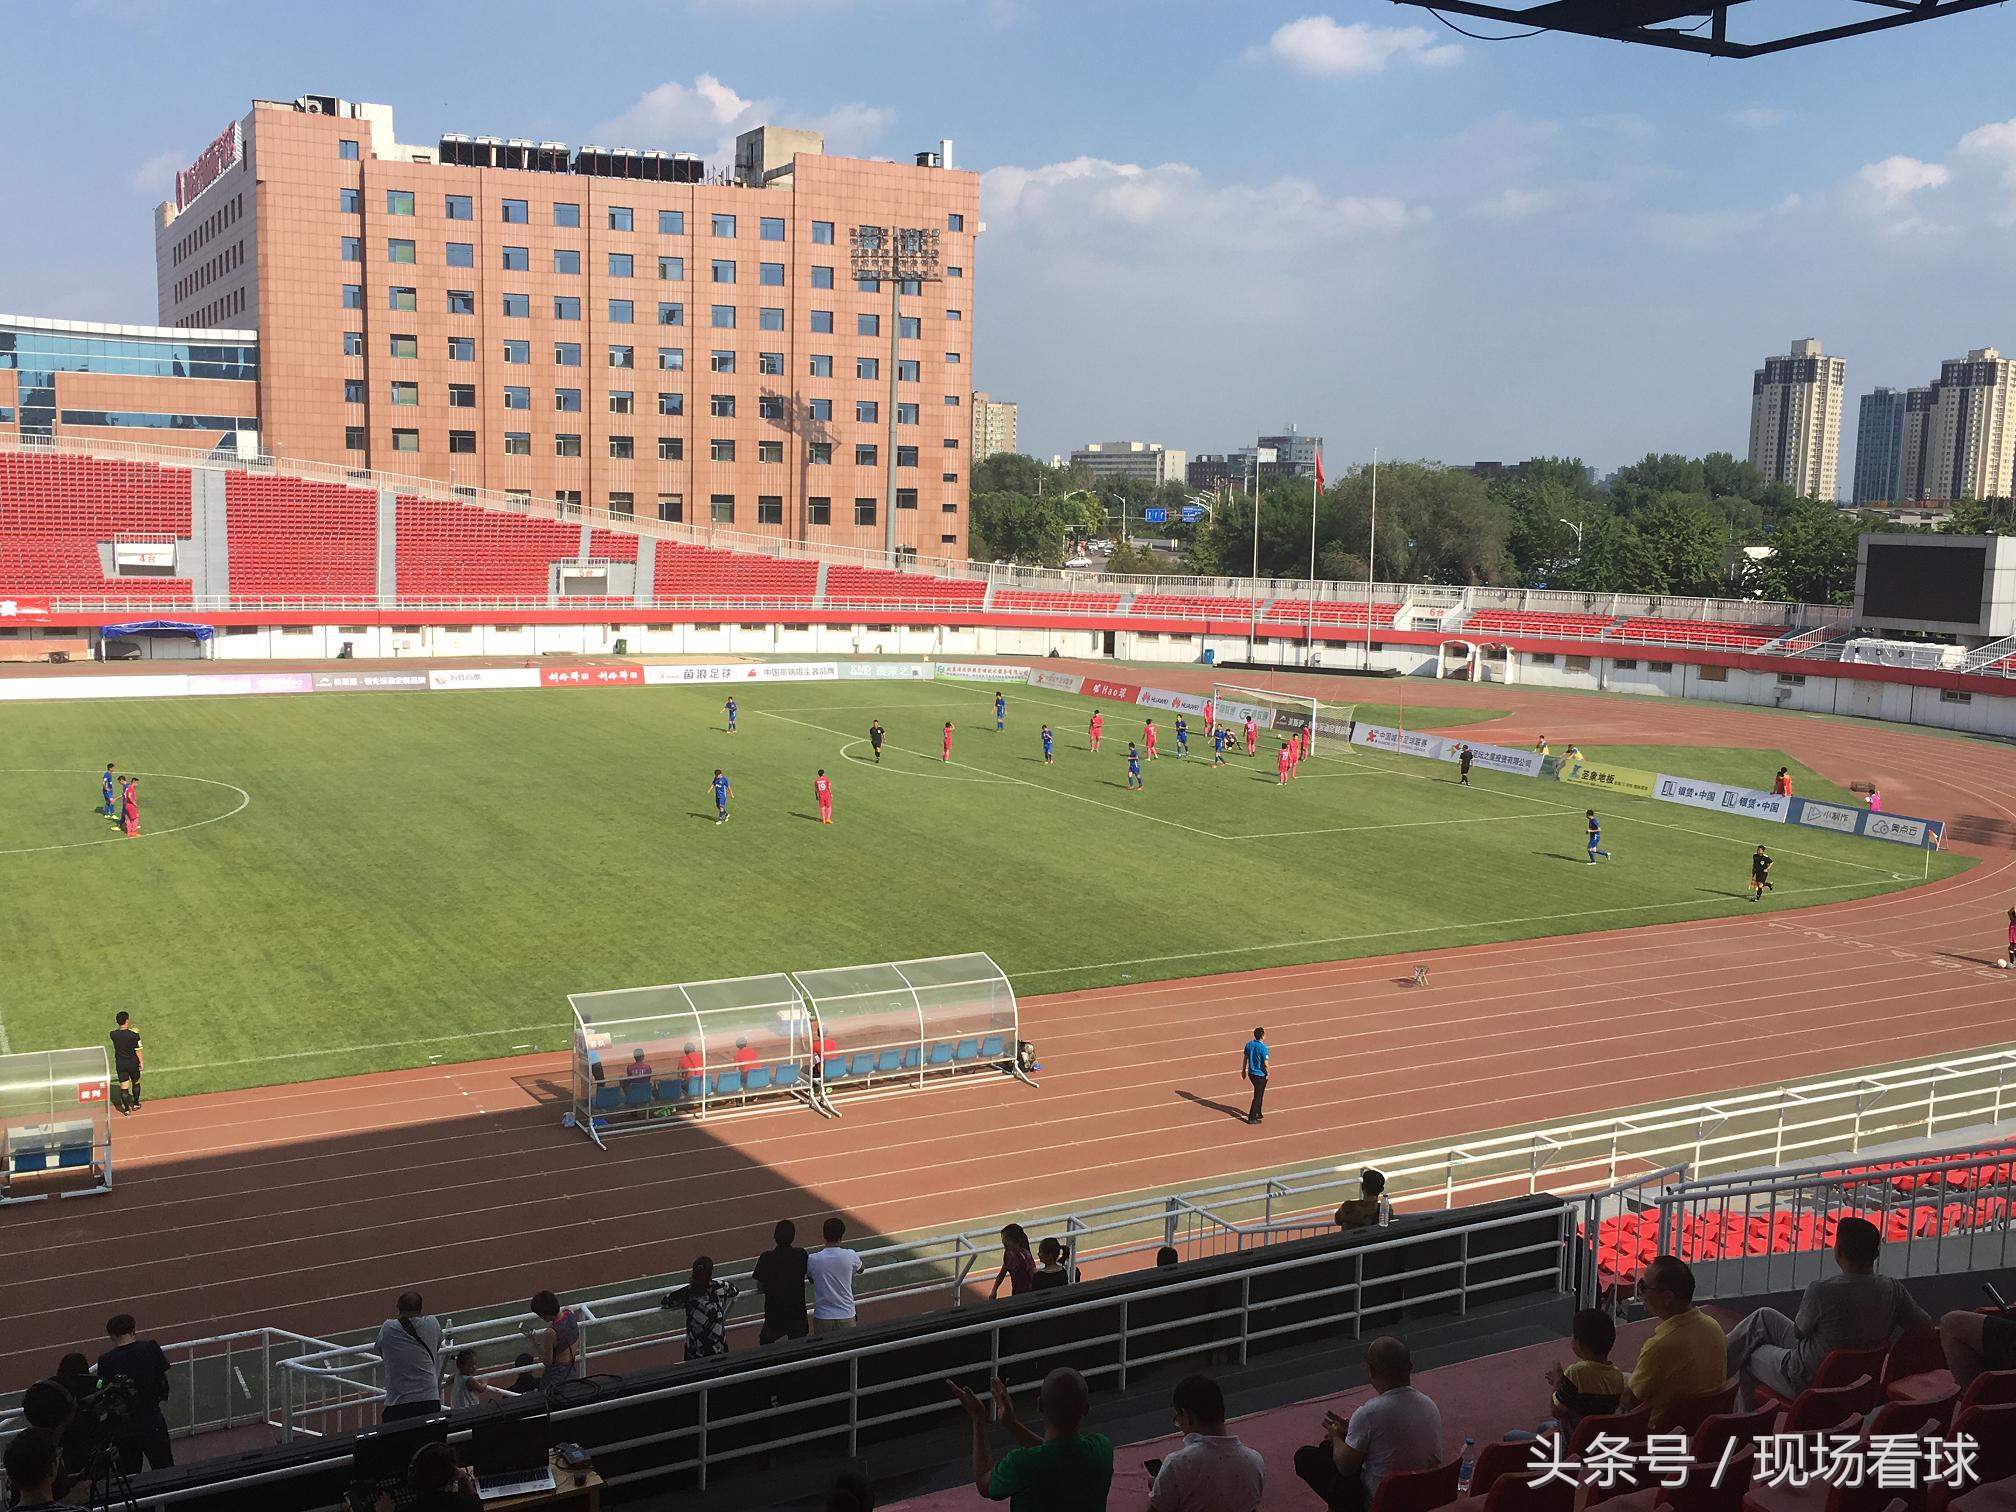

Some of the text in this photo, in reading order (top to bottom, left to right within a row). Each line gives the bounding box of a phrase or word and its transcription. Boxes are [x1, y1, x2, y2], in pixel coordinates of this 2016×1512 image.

[683, 668, 732, 680] 茵浪足球
[1151, 696, 1200, 711] HUAWEI HUAWEI
[1471, 749, 1532, 768] 足坛之星投资有限公司
[1581, 769, 1615, 785] 圣象地板
[817, 782, 827, 791] 19
[1822, 810, 1849, 823] 小制作
[1890, 823, 1918, 836] 奥点云
[1768, 922, 1794, 930] 1
[1803, 931, 1836, 939] 2
[1891, 949, 1918, 957] 4
[1928, 959, 1963, 969] 5
[1975, 970, 2008, 979] 6
